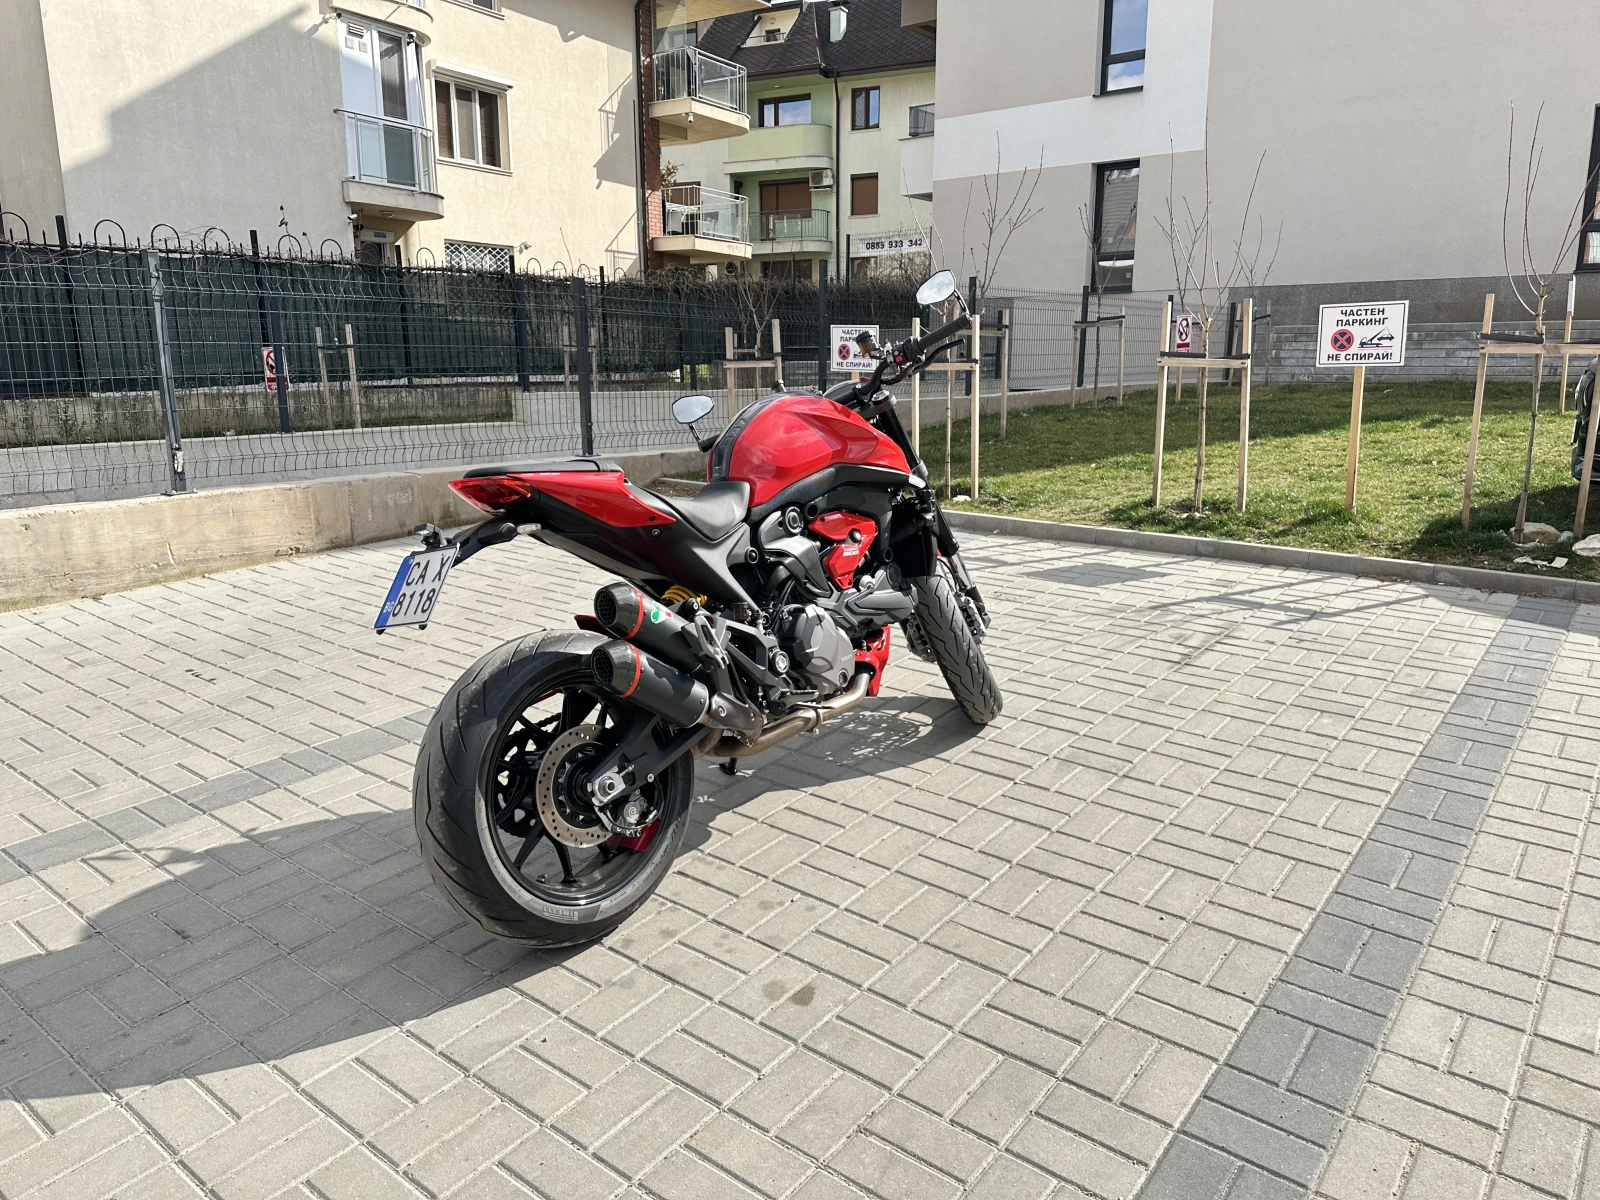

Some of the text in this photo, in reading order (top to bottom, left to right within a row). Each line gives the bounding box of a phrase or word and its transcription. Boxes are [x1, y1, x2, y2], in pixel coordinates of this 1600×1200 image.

[1340, 308, 1385, 317] ЧАСТЕН
[1336, 317, 1388, 327] ПАРКИНГ
[1327, 351, 1393, 361] НЕ СПИРАЙ!
[405, 555, 451, 587] CA X
[383, 601, 395, 613] BG
[391, 588, 436, 618] 8118
